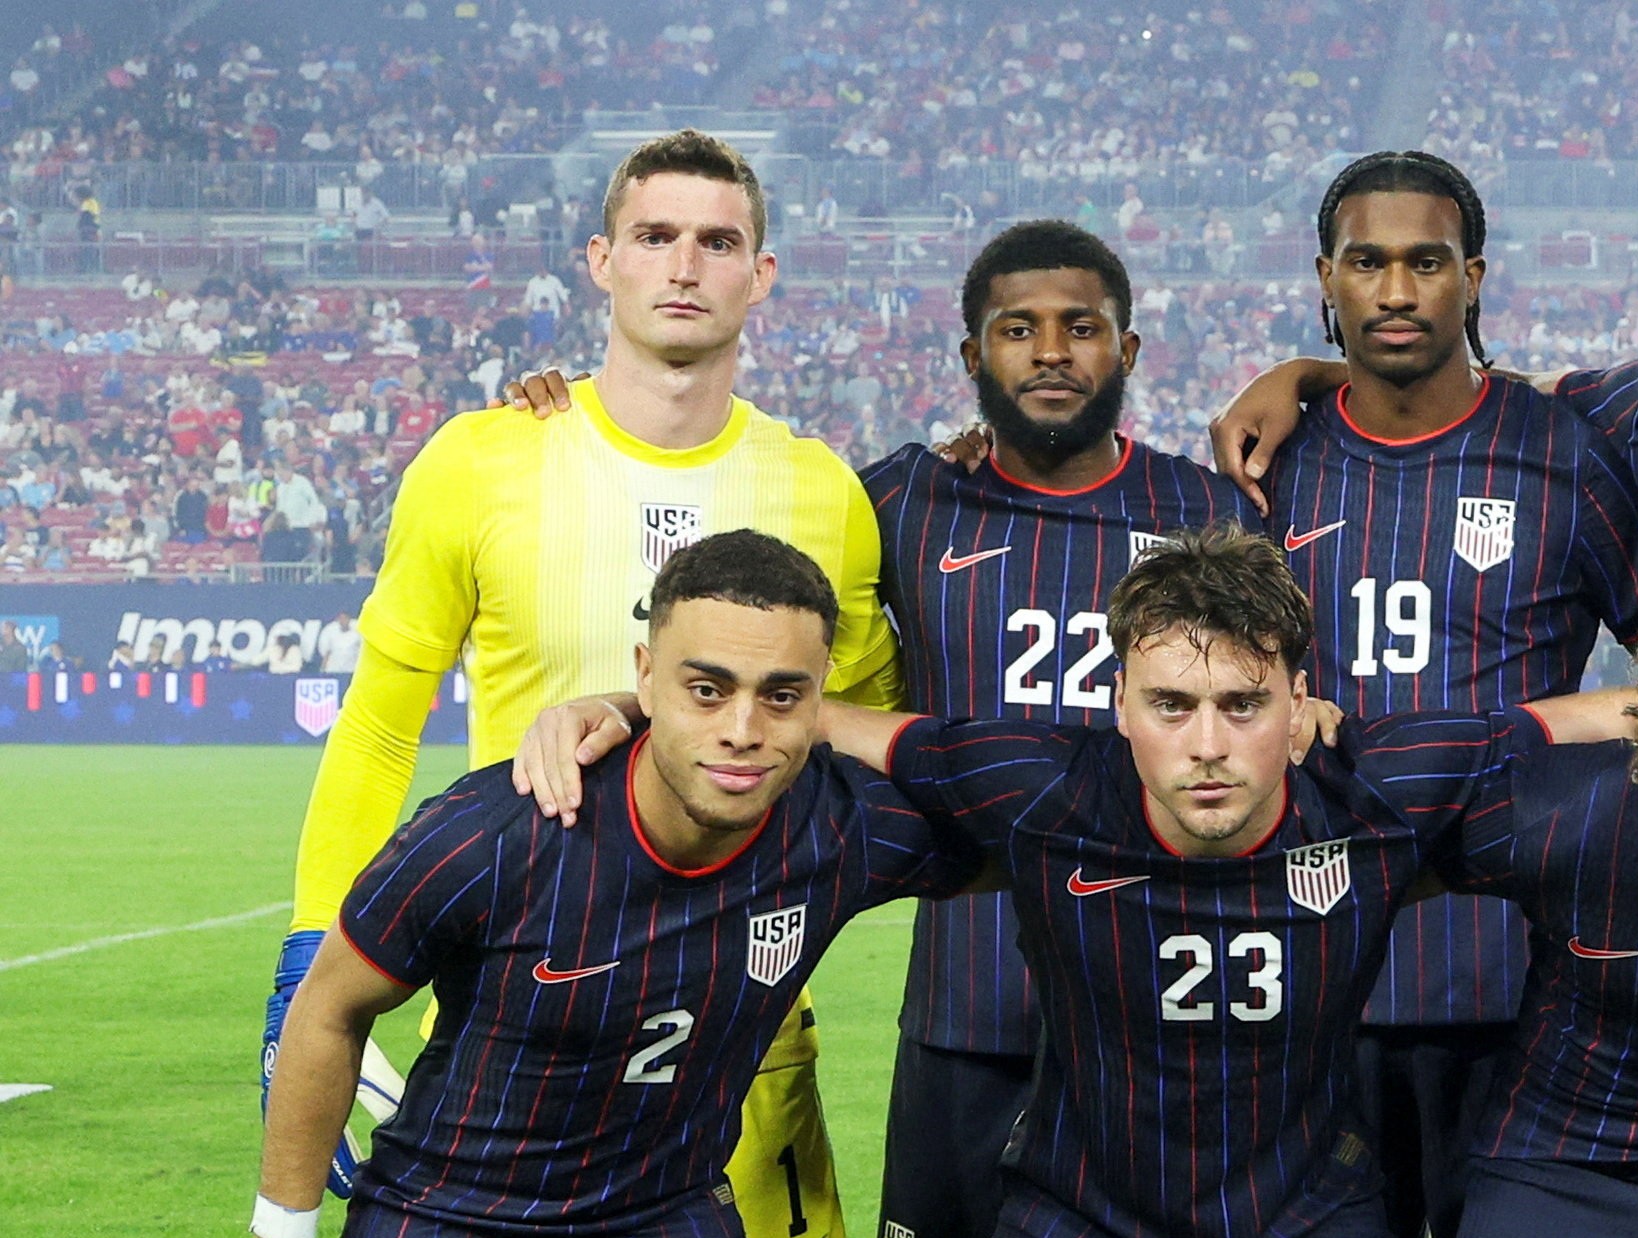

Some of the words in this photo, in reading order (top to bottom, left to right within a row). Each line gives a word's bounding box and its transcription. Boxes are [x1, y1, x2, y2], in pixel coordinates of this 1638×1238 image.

[116, 611, 358, 664] Impa
[1003, 607, 1115, 710] 22
[1350, 577, 1432, 677] 19
[299, 683, 335, 702] USA
[1289, 842, 1345, 869] USA
[753, 909, 802, 945] USA
[1158, 930, 1284, 1022] 23
[622, 1008, 696, 1084] 2
[776, 1144, 808, 1238] 1
